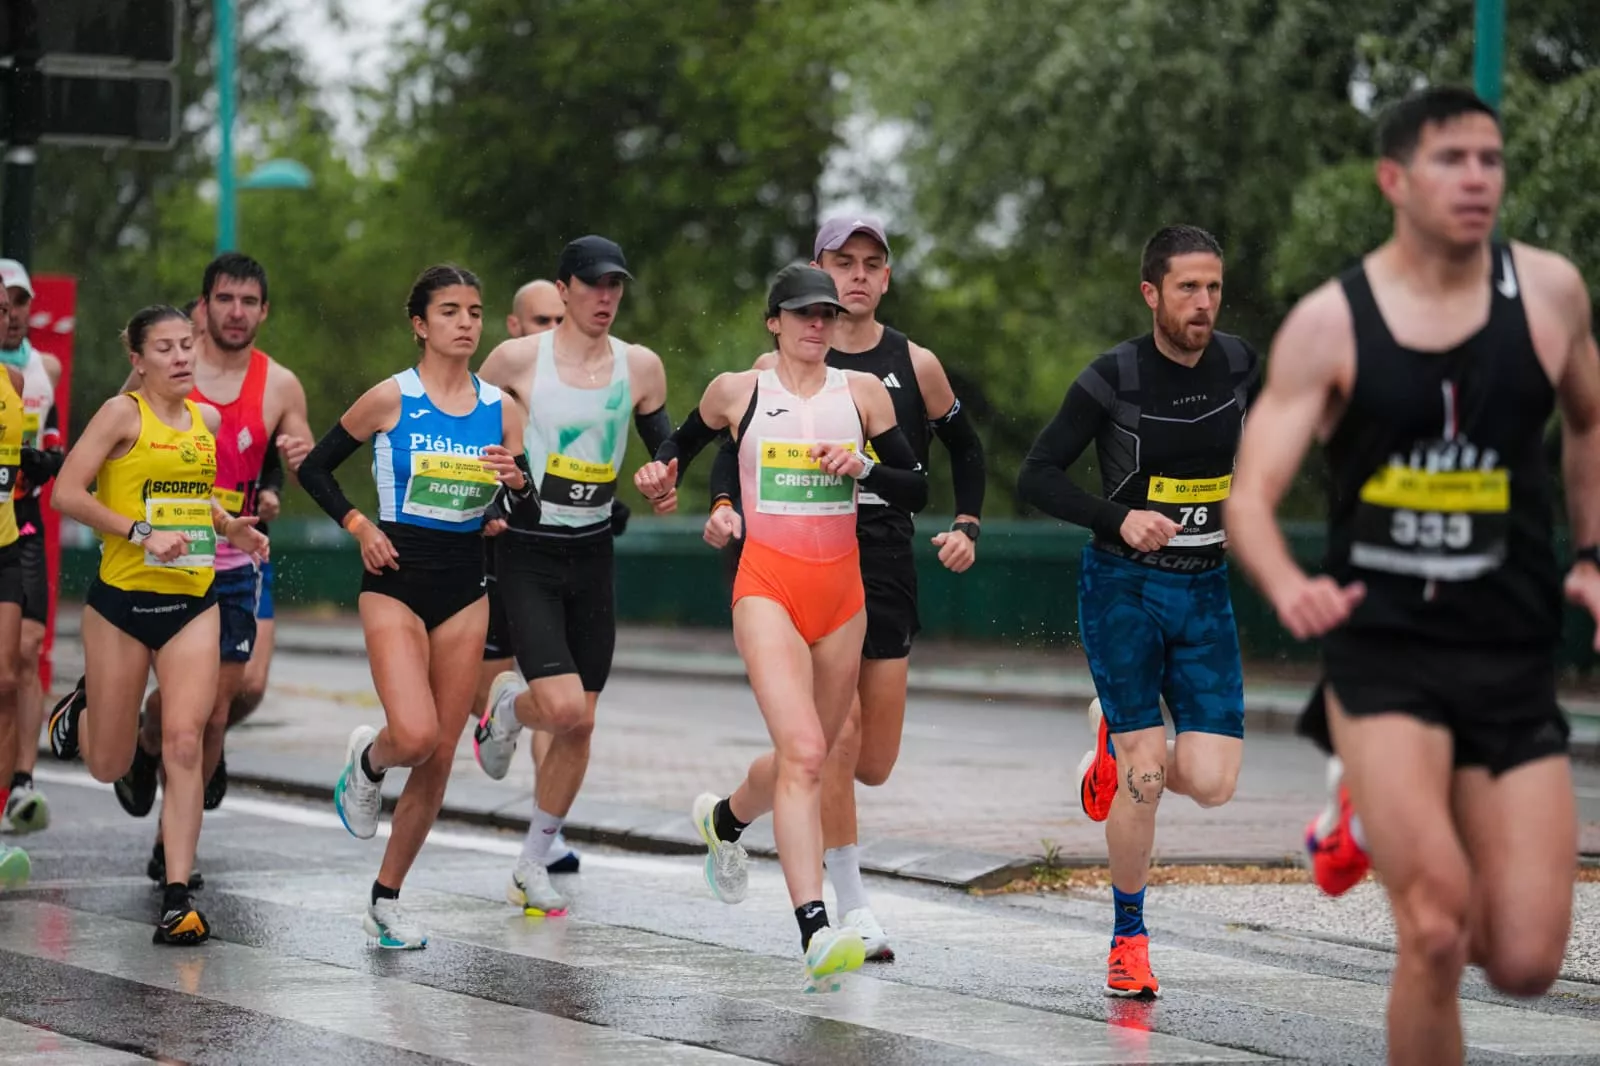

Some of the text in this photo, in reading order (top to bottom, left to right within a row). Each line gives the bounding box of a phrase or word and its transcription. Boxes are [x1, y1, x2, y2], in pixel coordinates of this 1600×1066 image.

[1172, 395, 1208, 406] KIPSTA
[774, 473, 843, 487] CRISTINA
[429, 482, 482, 497] RAQUEL
[569, 483, 598, 500] 37
[452, 499, 460, 507] 6
[1179, 506, 1208, 526] 76
[1391, 510, 1471, 549] 333
